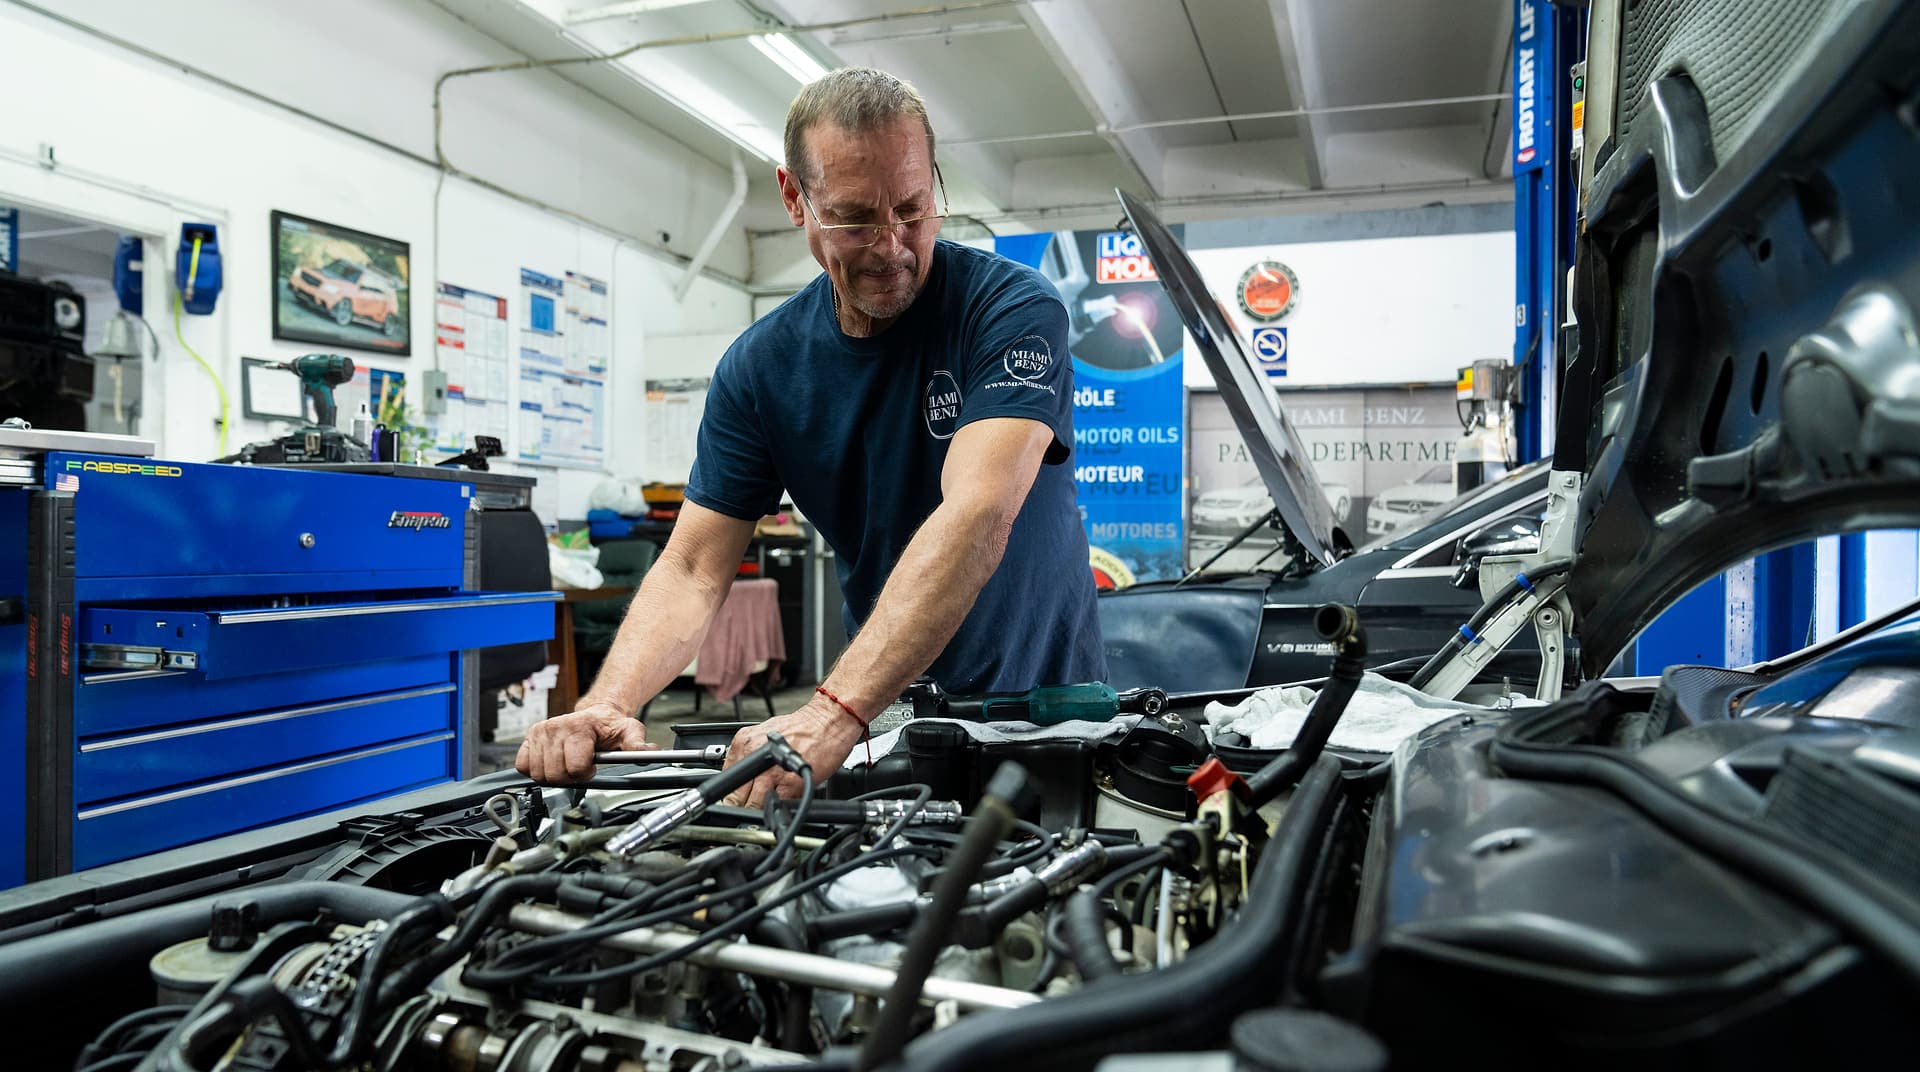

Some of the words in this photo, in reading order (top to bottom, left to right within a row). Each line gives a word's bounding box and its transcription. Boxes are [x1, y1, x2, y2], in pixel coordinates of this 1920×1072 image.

[1520, 0, 1534, 42] LIF
[1519, 48, 1534, 149] ROTARY
[1101, 236, 1145, 257] LIQ
[1101, 256, 1156, 279] MOL
[1011, 350, 1048, 364] MIAMI
[1014, 359, 1045, 371] BENZ
[1073, 387, 1115, 407] RÖLE
[1284, 407, 1345, 425] IAMI
[1073, 428, 1134, 444] MOTOR
[1137, 426, 1179, 443] OILS
[1312, 441, 1457, 462] DEPARTME
[66, 460, 182, 477] FABSPEED
[1074, 465, 1144, 483] MOTEUR
[1091, 521, 1177, 539] MOTORES
